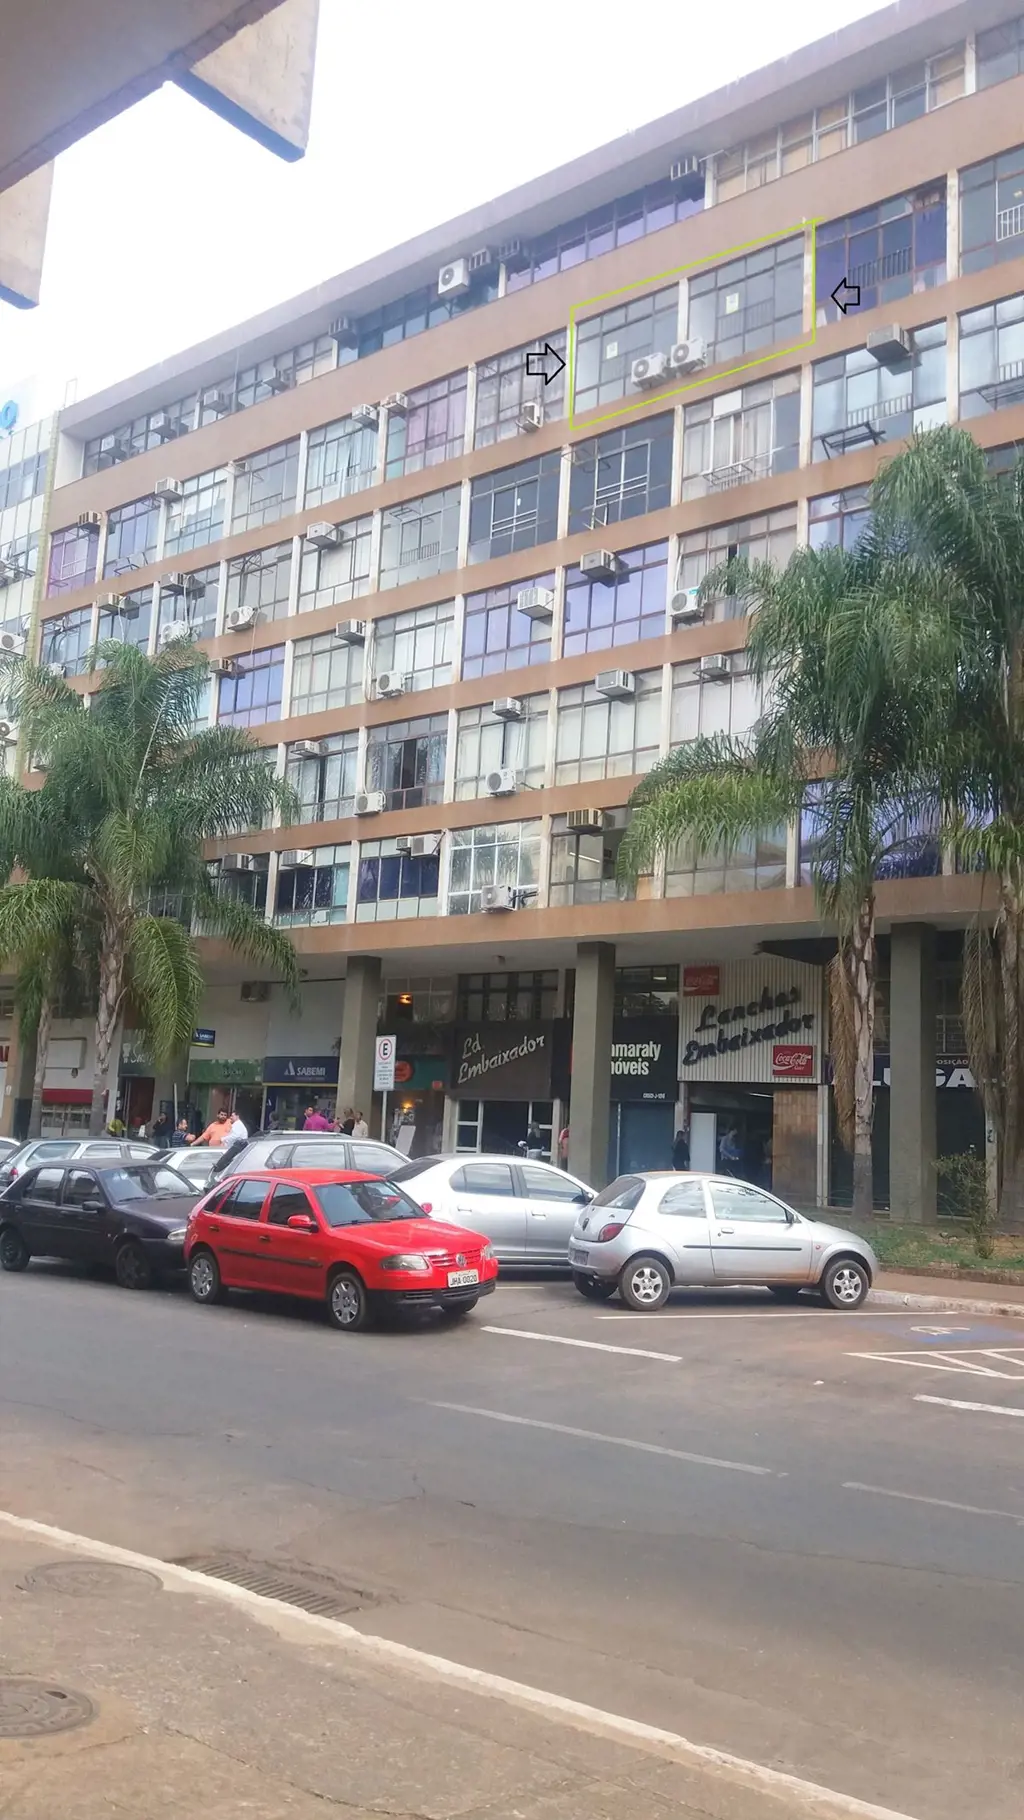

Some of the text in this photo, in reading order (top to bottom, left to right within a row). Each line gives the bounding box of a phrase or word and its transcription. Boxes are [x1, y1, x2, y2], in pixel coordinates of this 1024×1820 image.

[695, 986, 801, 1032] Lanches
[683, 1010, 814, 1066] Embaixador
[382, 1043, 389, 1056] E
[611, 1041, 661, 1061] maraty
[458, 1036, 545, 1084] Embaixador
[611, 1058, 649, 1075] óveis
[936, 1058, 969, 1066] OSIÇÃO
[297, 1066, 326, 1076] SABEMI
